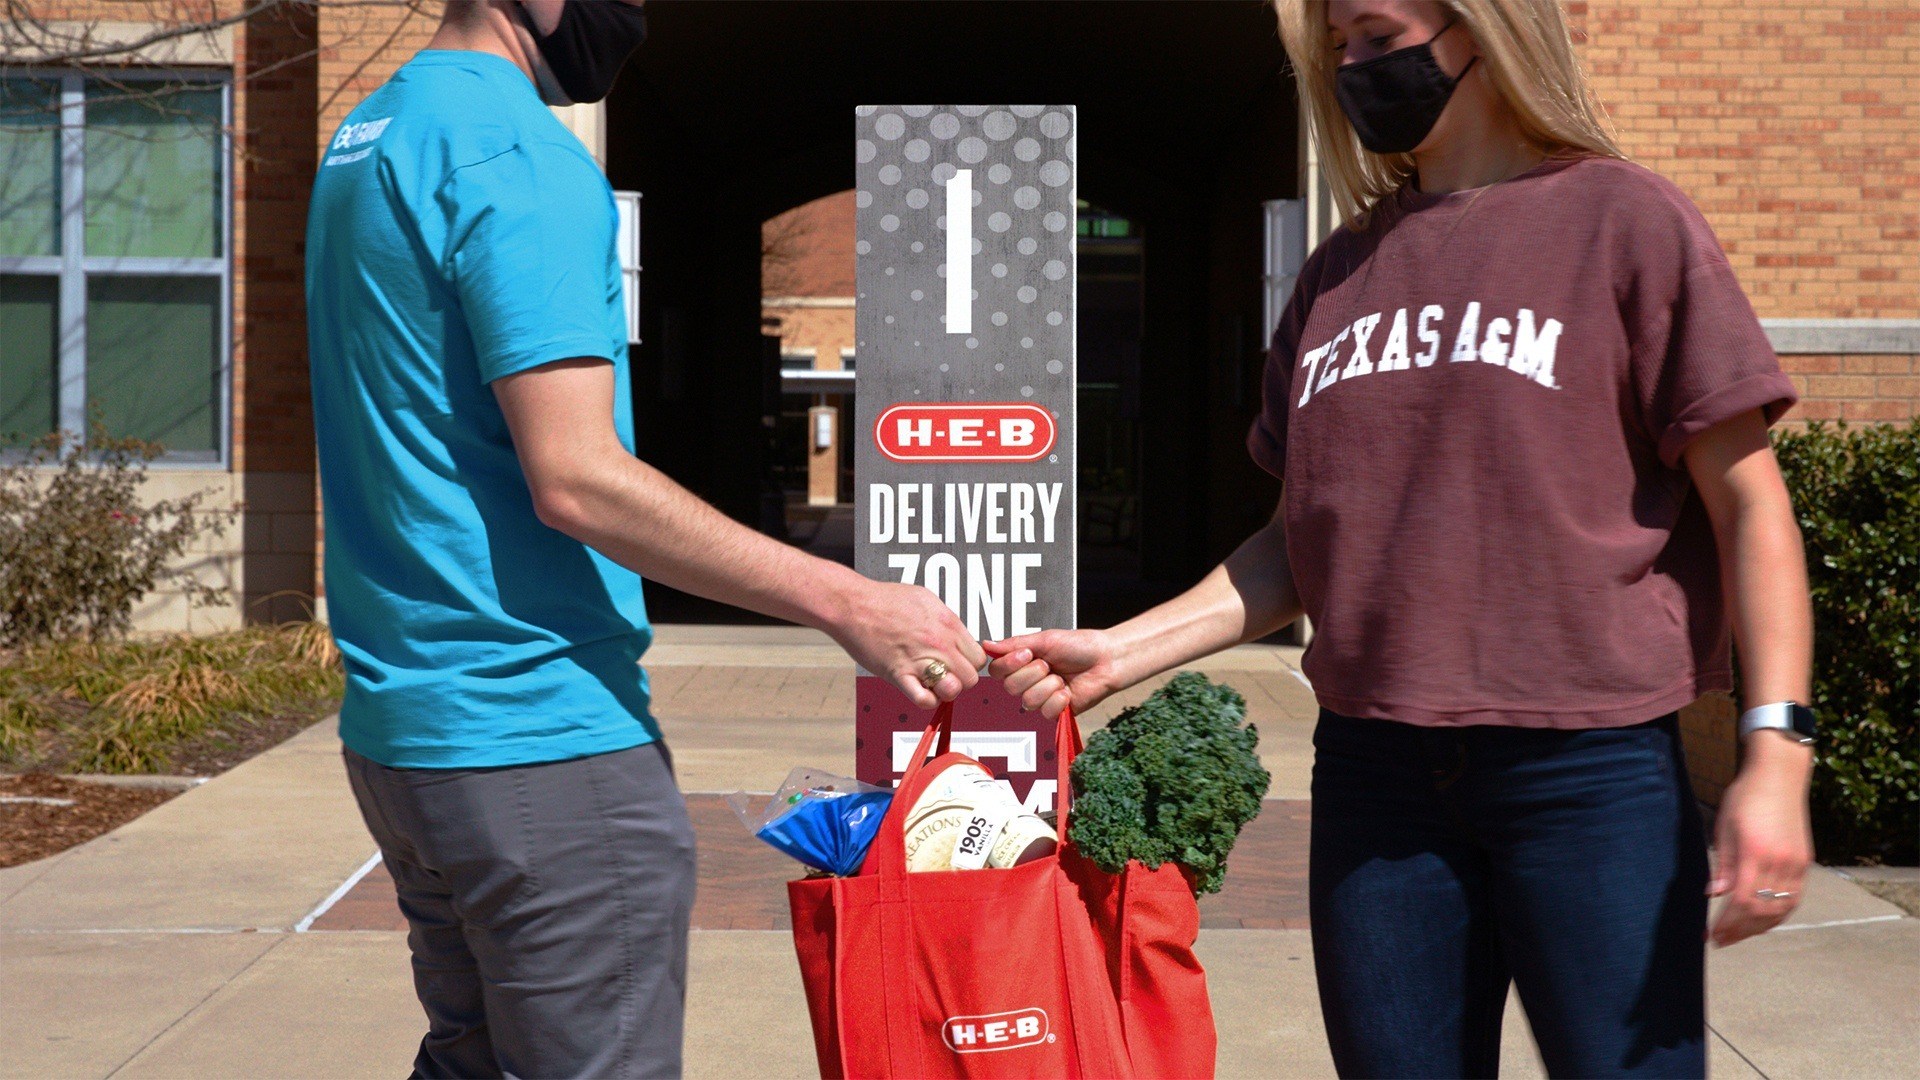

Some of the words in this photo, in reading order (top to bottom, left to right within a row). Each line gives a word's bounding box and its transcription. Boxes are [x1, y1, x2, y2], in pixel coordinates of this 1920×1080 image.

[946, 169, 972, 333] 1
[1298, 304, 1444, 409] TEXAS
[1450, 301, 1563, 388] A&M
[897, 418, 1036, 447] H-E-B
[869, 482, 1063, 543] DELIVERY
[905, 816, 962, 866] REATIONS
[959, 816, 987, 855] 1905
[974, 824, 994, 856] VANILLA
[952, 1016, 1040, 1046] H-E-B
